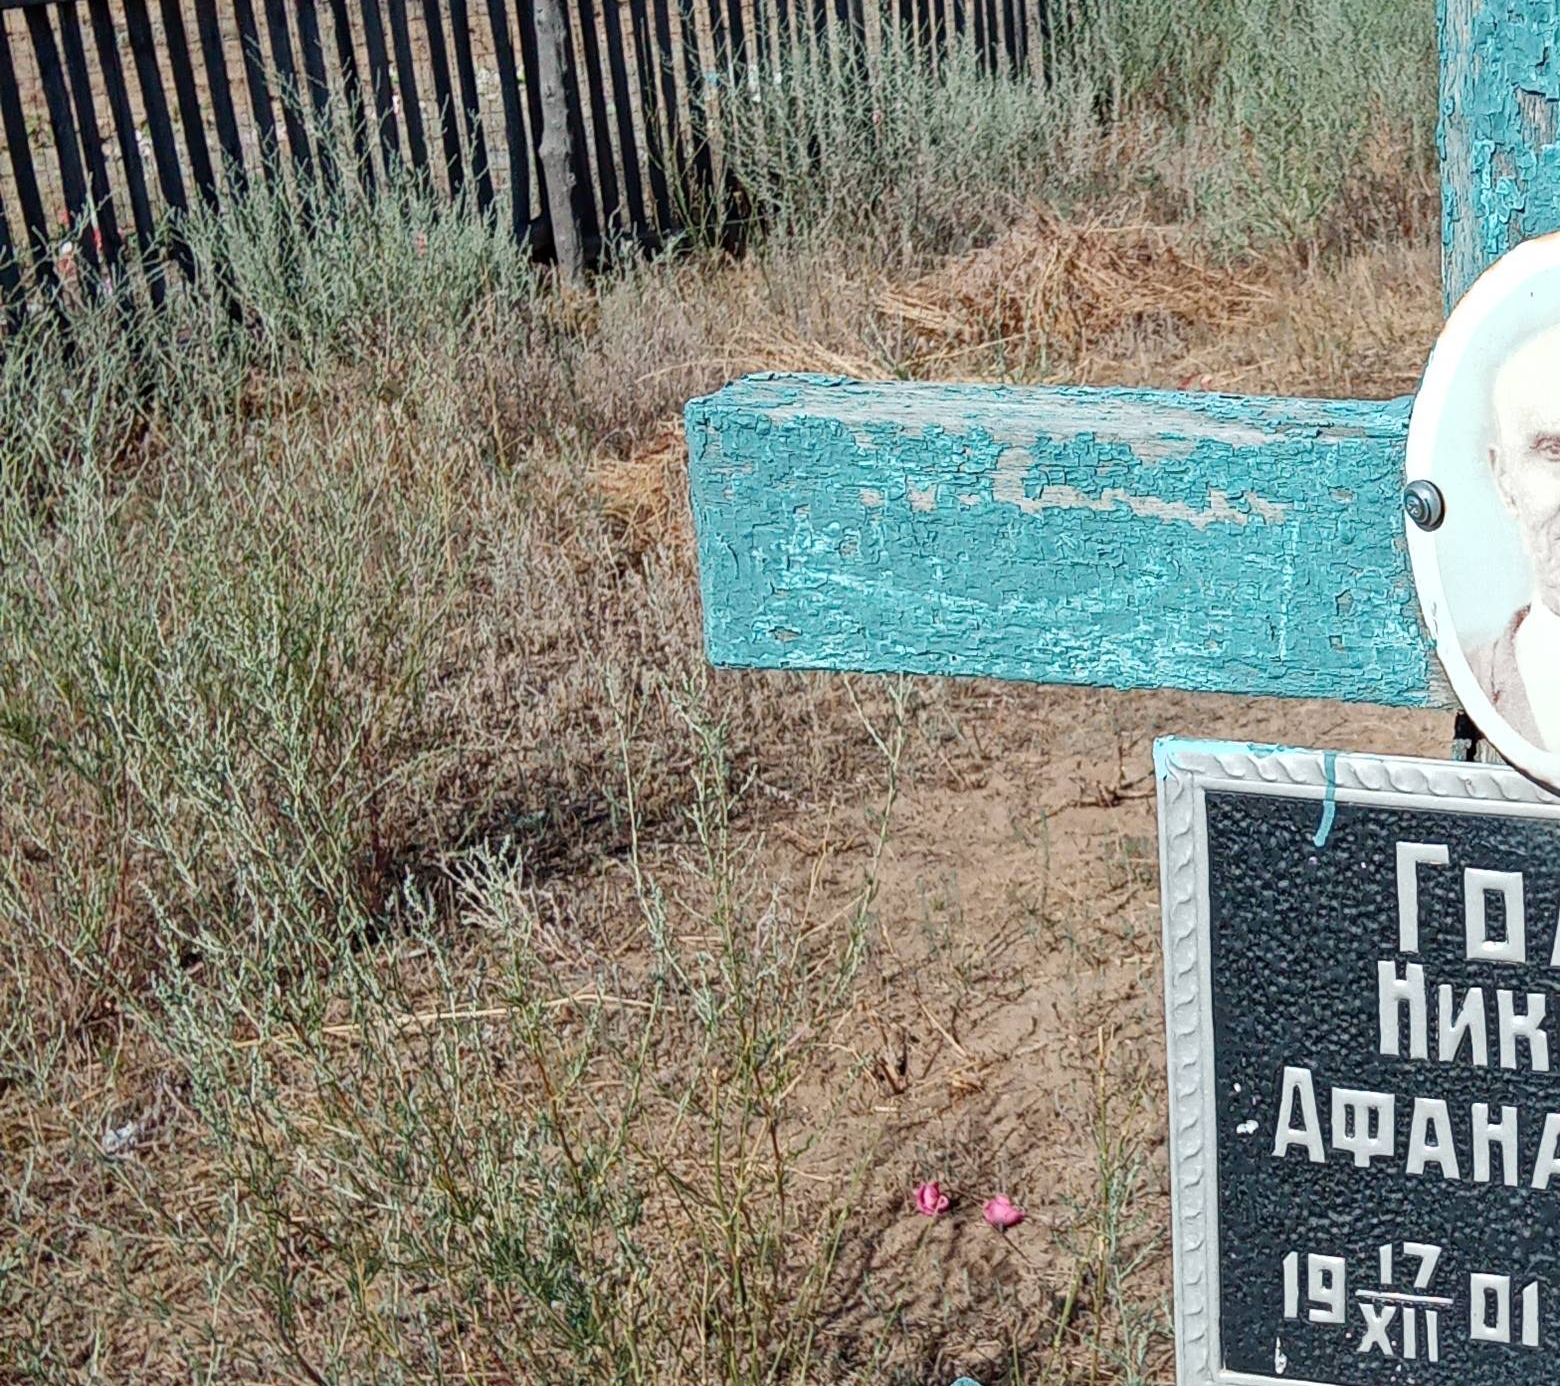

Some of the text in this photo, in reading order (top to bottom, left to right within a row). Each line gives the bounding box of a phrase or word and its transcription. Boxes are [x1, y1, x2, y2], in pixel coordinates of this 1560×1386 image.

[1282, 1250, 1347, 1324] 19
[1380, 1242, 1442, 1290] 17
[1469, 1271, 1540, 1347] 01
